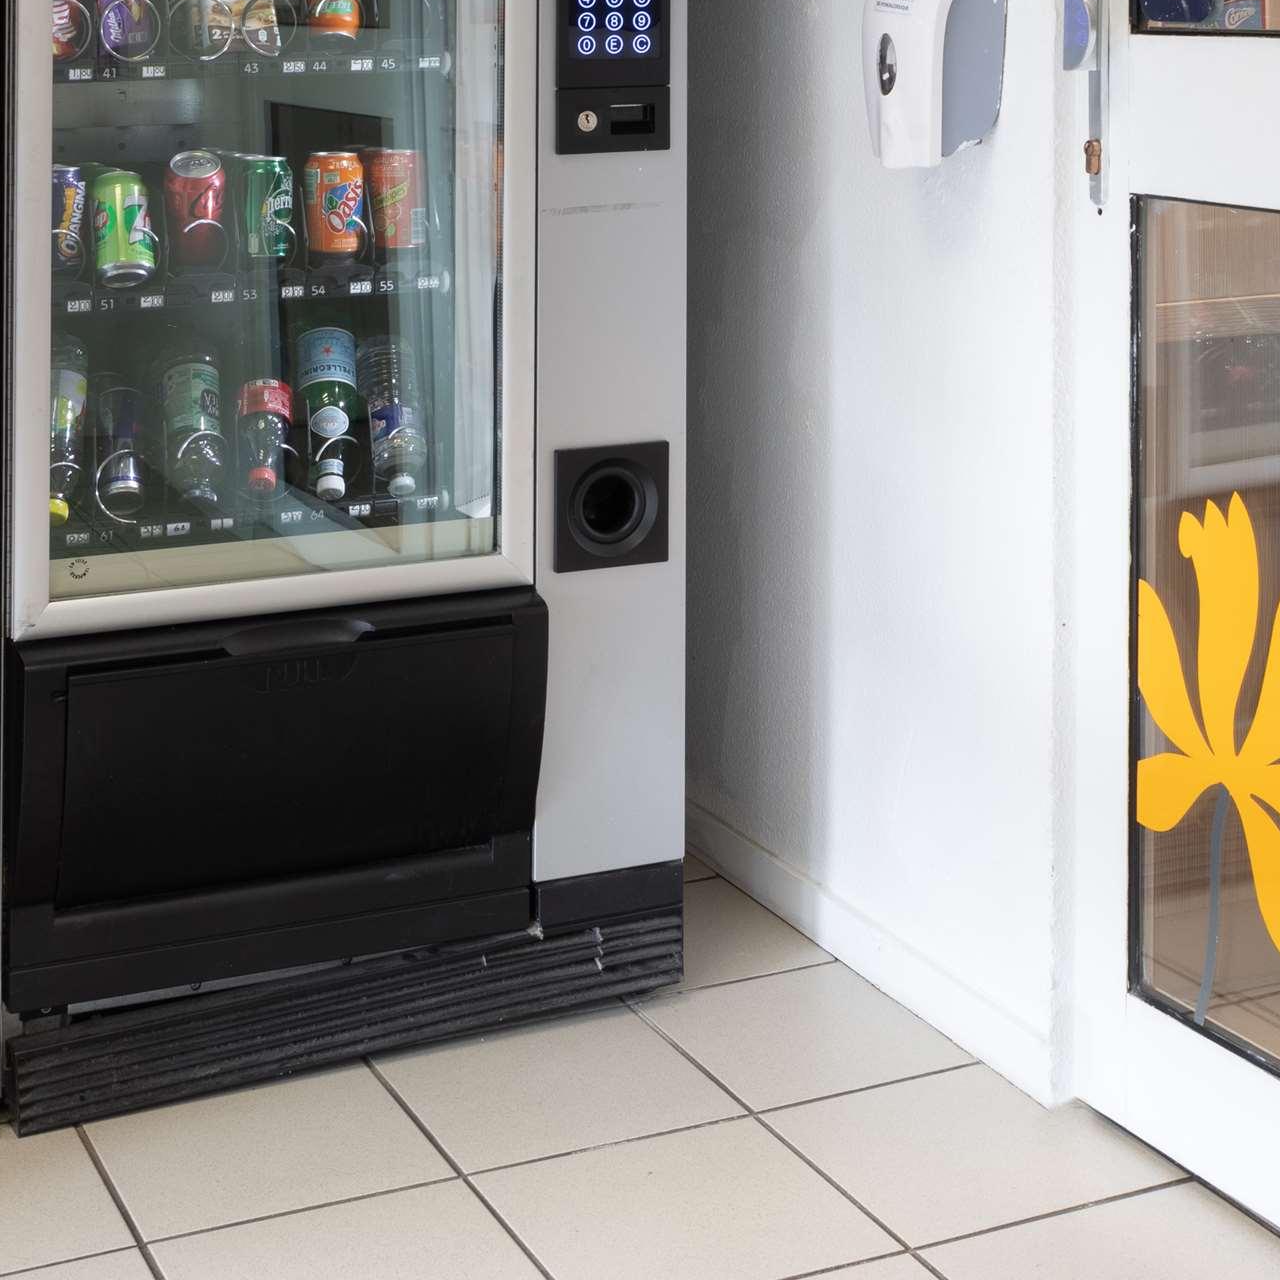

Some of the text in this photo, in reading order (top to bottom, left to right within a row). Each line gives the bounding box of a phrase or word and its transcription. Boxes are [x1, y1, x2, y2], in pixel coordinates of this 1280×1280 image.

[244, 63, 259, 73] 43
[312, 62, 326, 71] 44
[381, 59, 396, 69] 45
[102, 68, 116, 78] 41
[324, 176, 364, 234] Oasis
[311, 286, 326, 296] 54
[379, 282, 394, 291] 55
[242, 290, 257, 300] 53
[100, 299, 114, 310] 51
[310, 510, 324, 520] 64
[100, 531, 113, 541] 61
